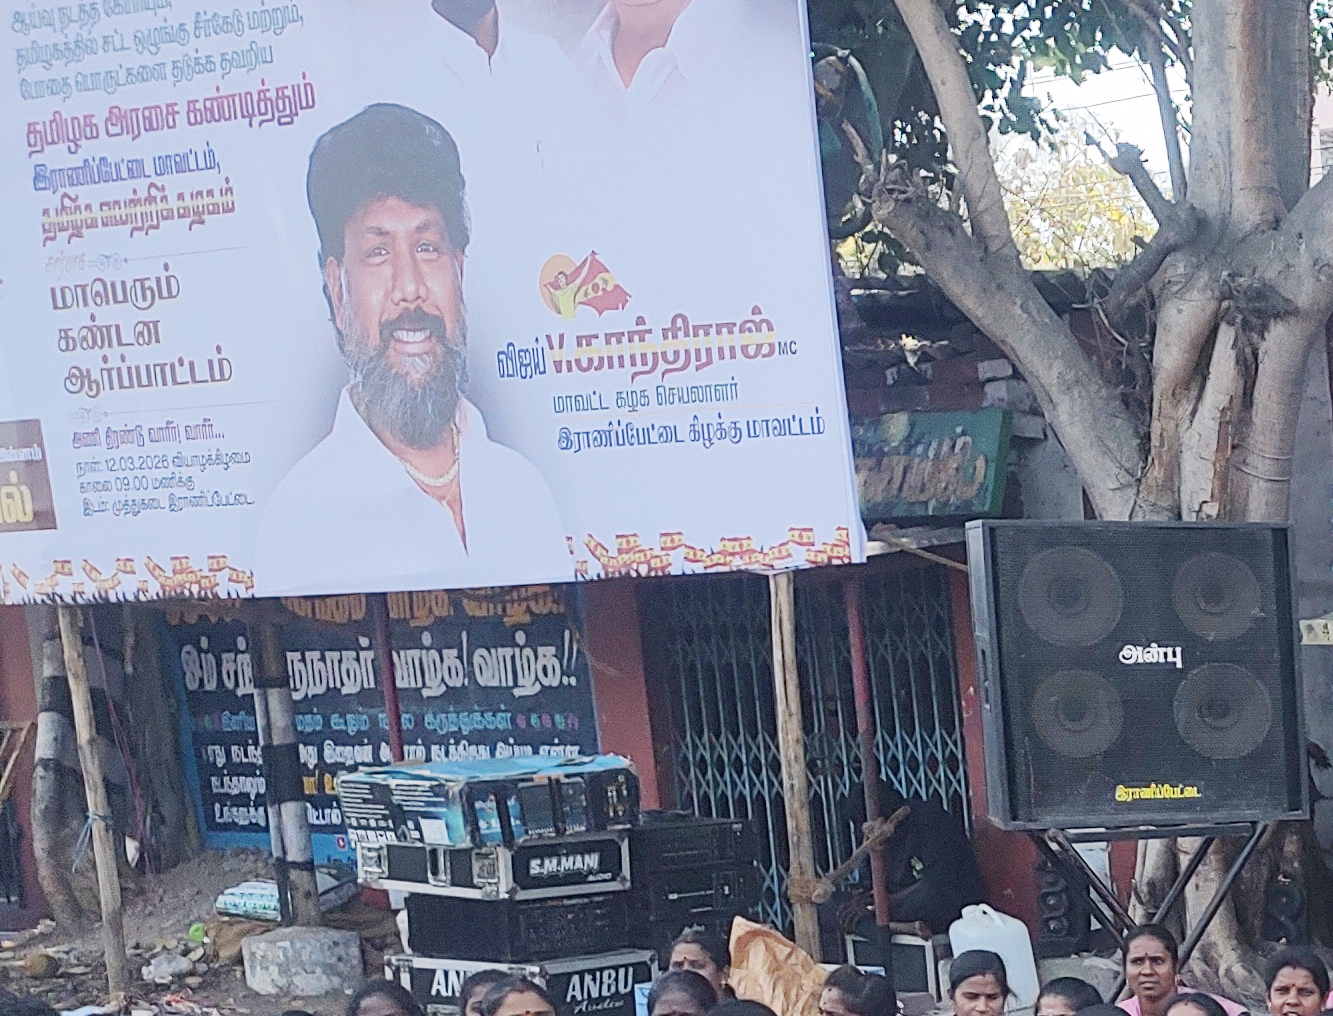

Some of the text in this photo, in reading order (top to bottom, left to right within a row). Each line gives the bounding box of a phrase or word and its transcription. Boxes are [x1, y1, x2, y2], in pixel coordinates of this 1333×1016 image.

[26, 70, 317, 158] தமிழக அரசை கண்டித்தும்
[33, 155, 152, 195] இராணிப்பேட்டை
[50, 262, 180, 312] மாபெரும்
[58, 312, 162, 353] கண்டன
[64, 344, 234, 399] ஆர்ப்பாட்டம்
[496, 336, 547, 380] விஜய்
[777, 340, 798, 356] MC
[553, 376, 739, 414] மாவட்ட கழக செயலாளர்
[557, 406, 826, 453] இராணிப்பேட்டை கிழக்கு மாவட்டம்
[105, 454, 170, 472] 12.03.2026
[114, 475, 149, 492] 09.00
[222, 635, 376, 701] சற்ருநாதர்
[473, 628, 578, 698] வாழ்க!!
[1118, 642, 1184, 668] அன்பு
[1115, 782, 1202, 801] இராணிப்பேட்டை
[529, 852, 600, 876] S.M.MANI
[566, 966, 634, 1003] ANBU
